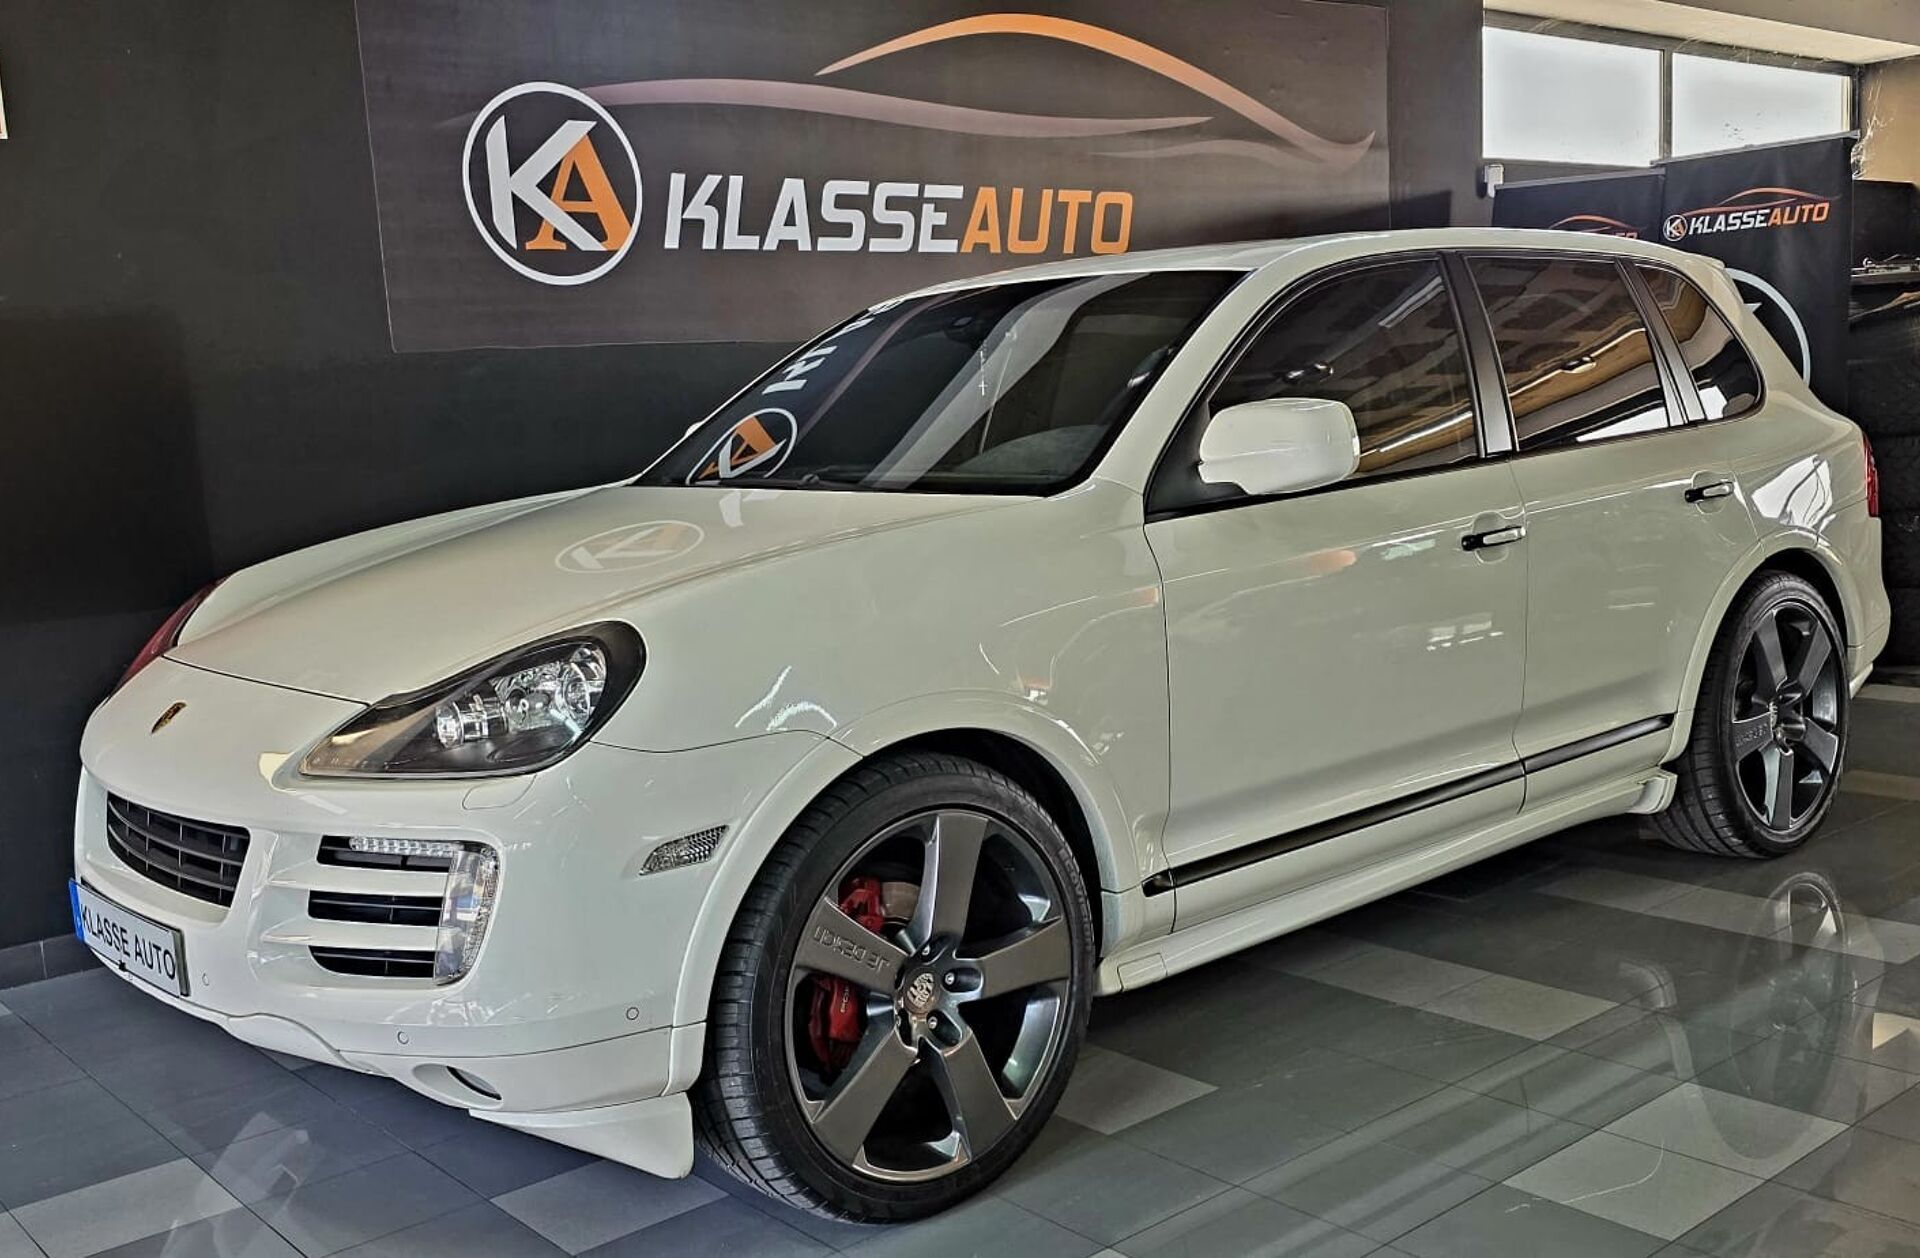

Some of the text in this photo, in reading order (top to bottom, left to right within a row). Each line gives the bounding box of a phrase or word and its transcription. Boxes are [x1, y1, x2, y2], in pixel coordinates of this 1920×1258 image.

[485, 115, 1134, 255] KA KLASSEAUTO
[1689, 203, 1829, 235] KLASSEAUTO
[82, 905, 176, 980] KLASSE AUTO
